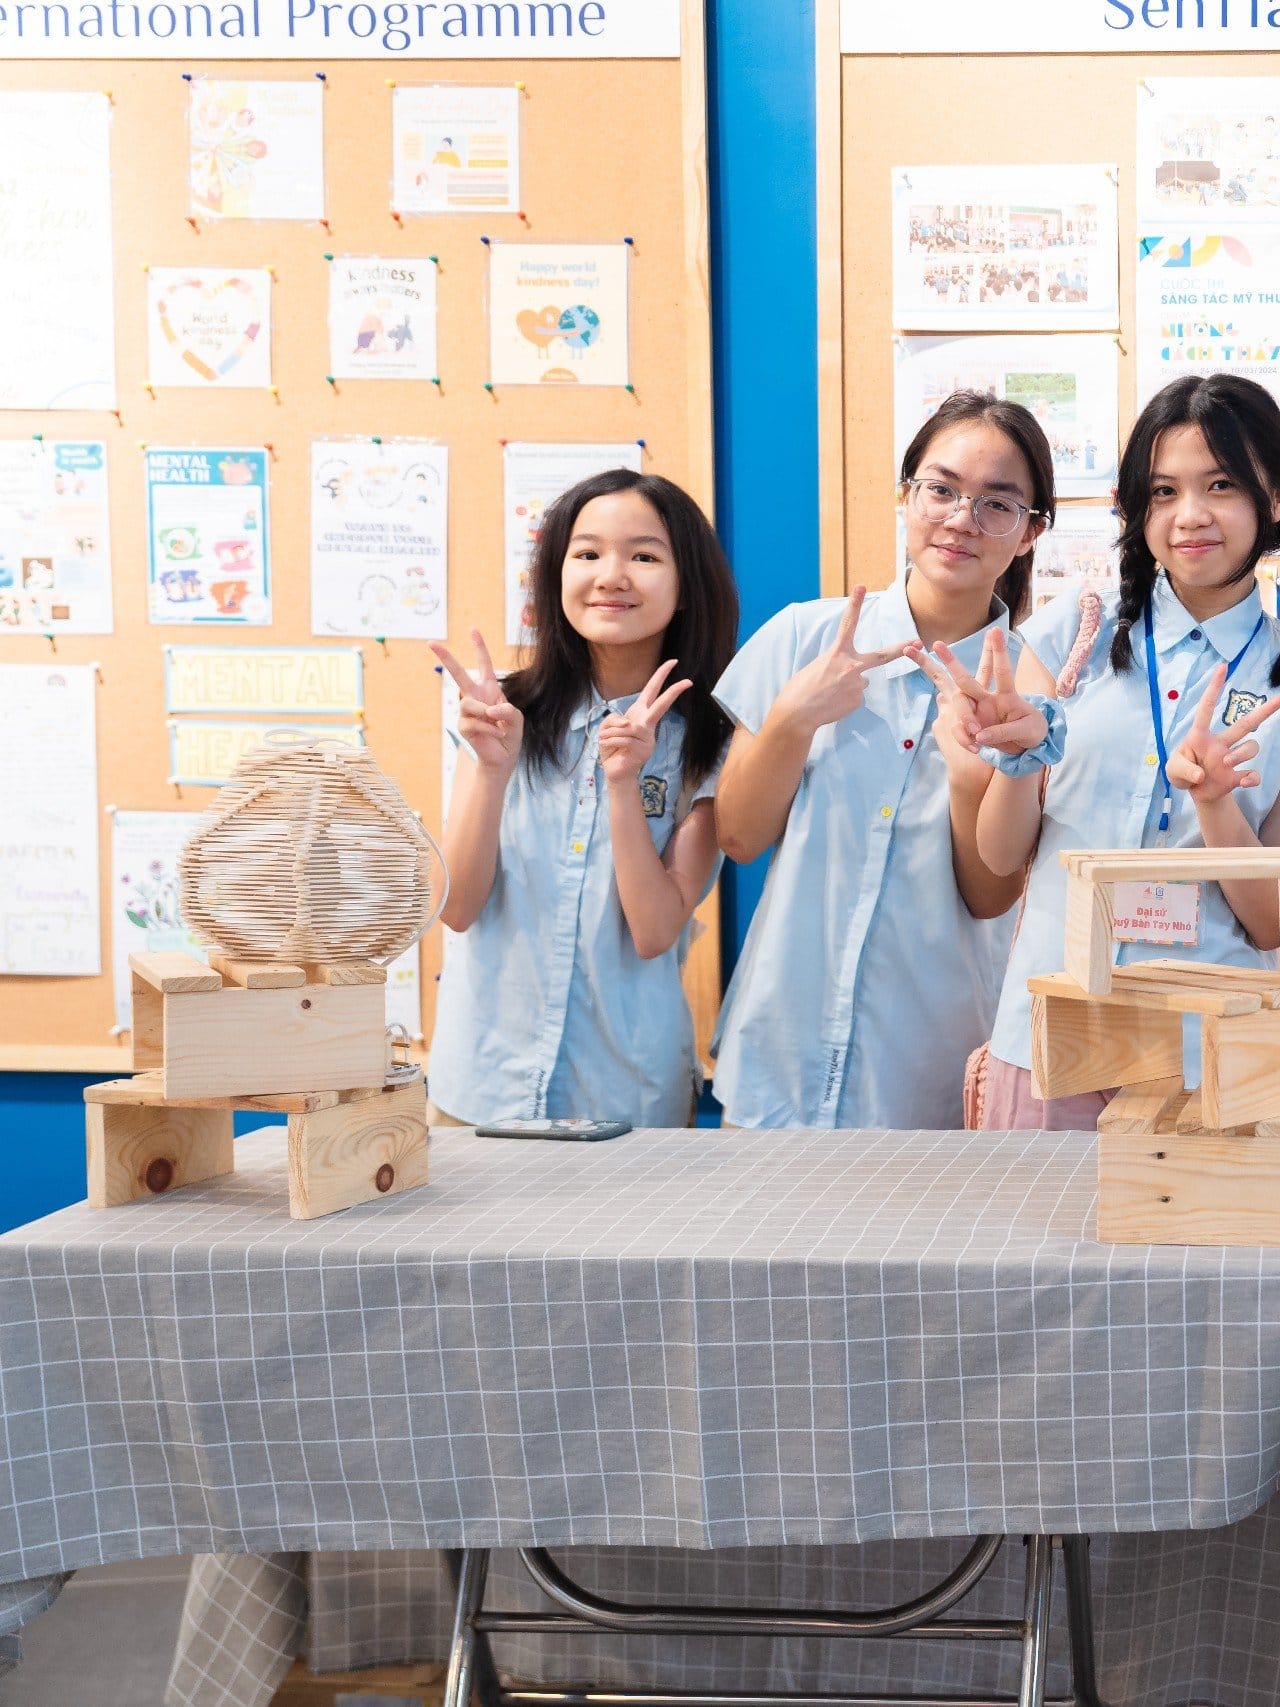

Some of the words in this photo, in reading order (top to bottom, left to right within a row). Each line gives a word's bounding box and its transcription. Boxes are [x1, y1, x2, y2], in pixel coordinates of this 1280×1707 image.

[288, 0, 605, 50] Programme
[150, 454, 210, 469] MENTAL
[150, 468, 210, 482] HEALTH
[178, 654, 354, 704] MENTAL
